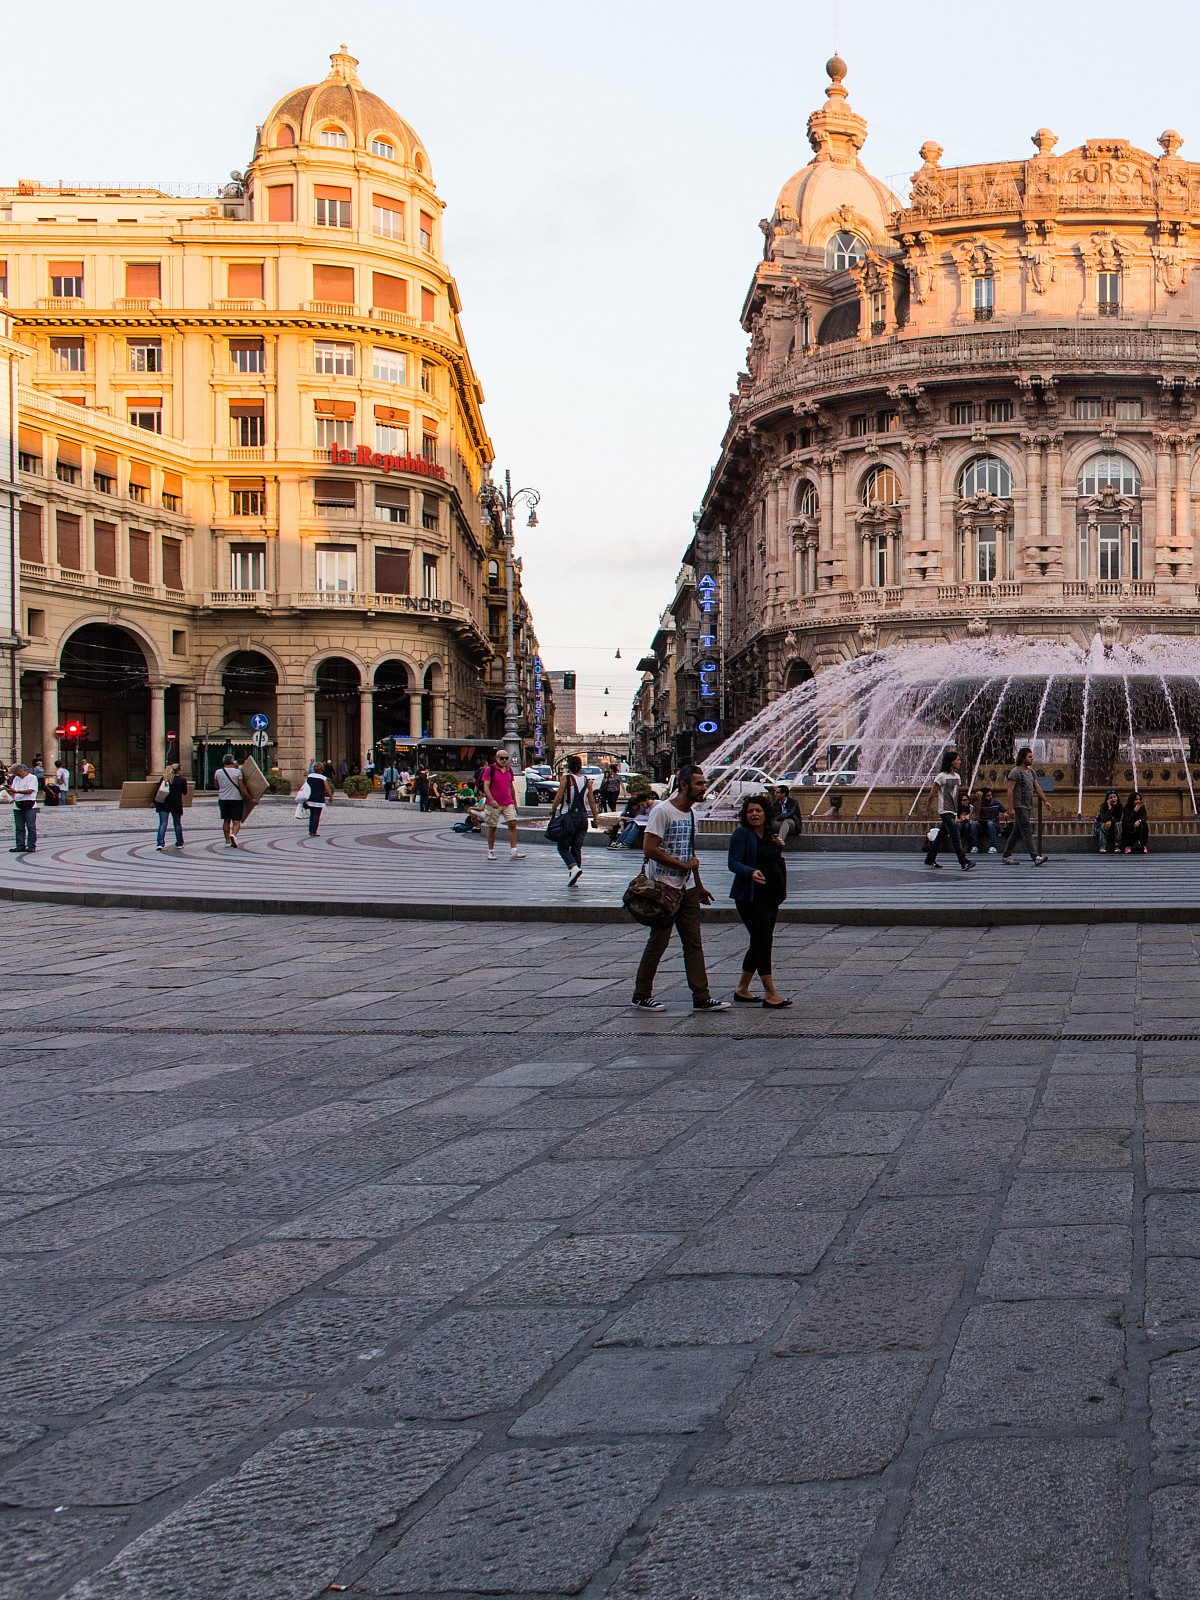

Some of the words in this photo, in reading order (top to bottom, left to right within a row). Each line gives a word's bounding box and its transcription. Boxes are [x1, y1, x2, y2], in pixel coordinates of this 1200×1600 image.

[1067, 162, 1151, 184] BORSA
[331, 442, 351, 464] la
[356, 444, 446, 480] Repubblica
[534, 658, 543, 698] HOTEL
